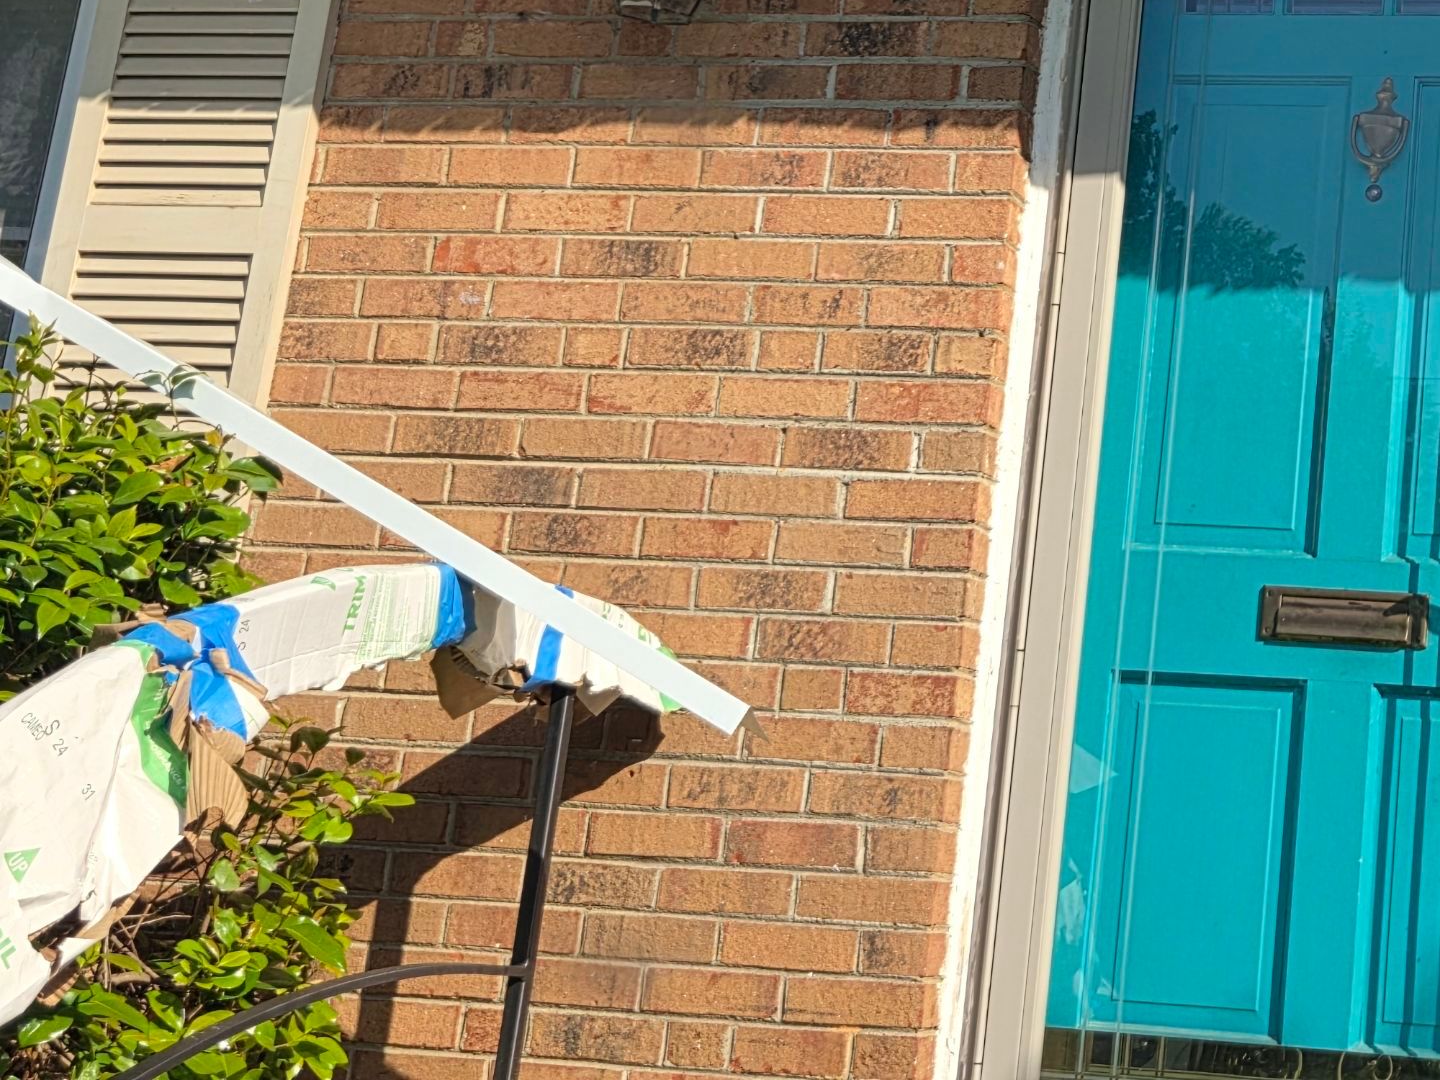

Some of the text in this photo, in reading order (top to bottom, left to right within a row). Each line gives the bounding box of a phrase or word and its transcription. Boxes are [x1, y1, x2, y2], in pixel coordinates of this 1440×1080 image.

[343, 575, 367, 634] TRIM
[52, 738, 69, 757] 24
[8, 851, 29, 872] UP
[0, 928, 17, 970] IL
